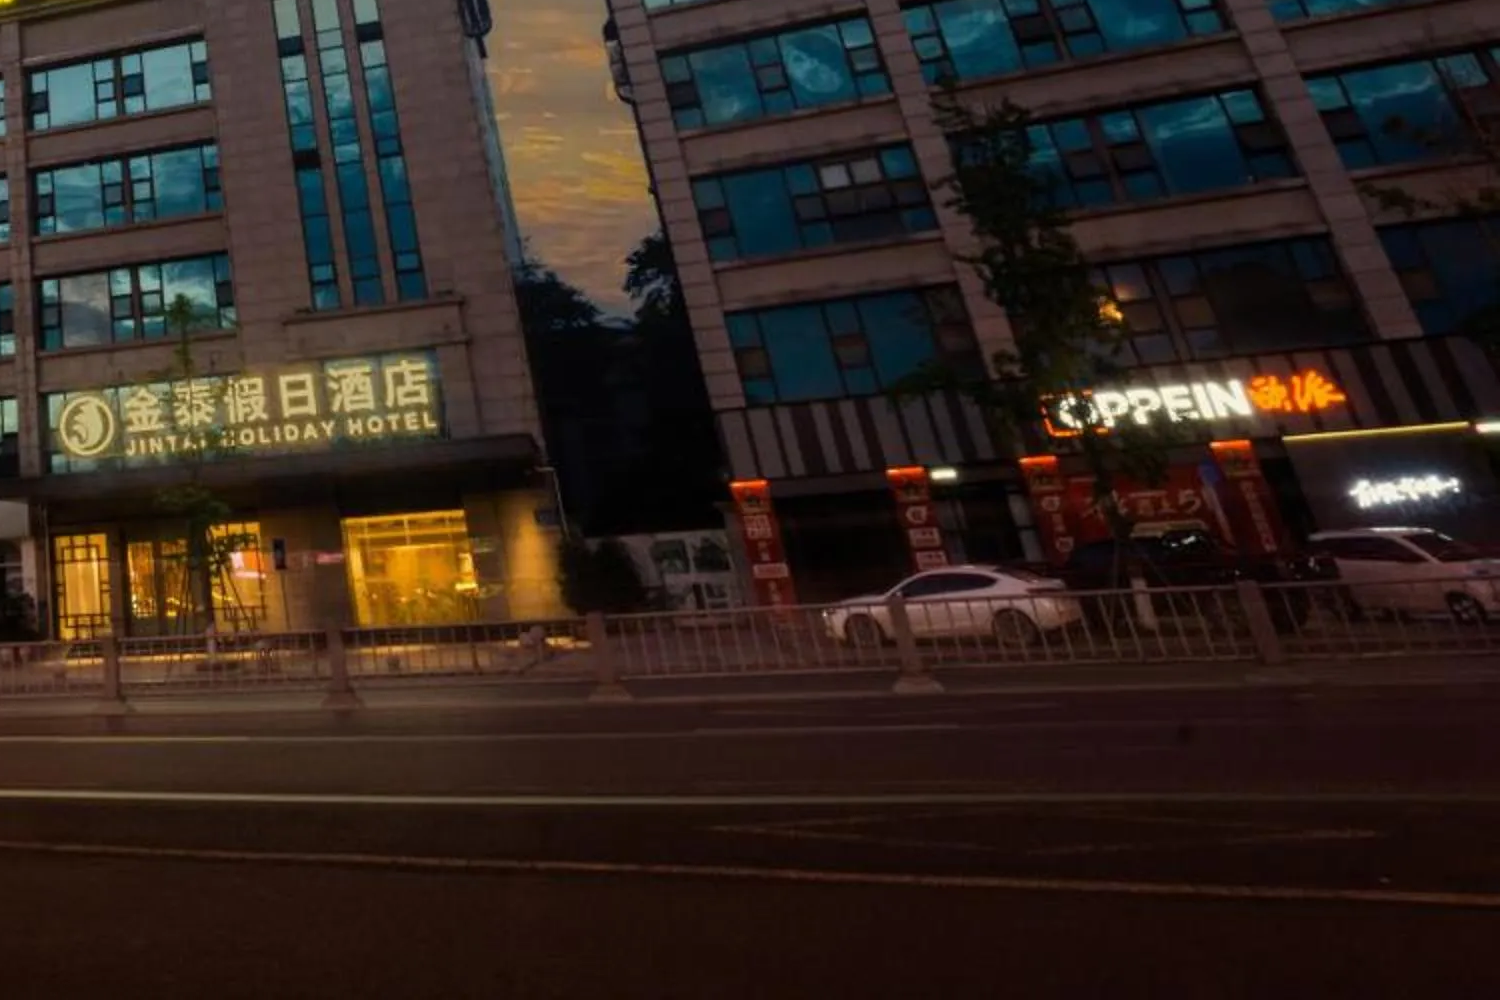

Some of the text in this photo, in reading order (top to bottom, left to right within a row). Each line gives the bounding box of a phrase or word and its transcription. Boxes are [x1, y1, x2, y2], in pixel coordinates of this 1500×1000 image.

[124, 360, 430, 433] 金泰假日酒店
[1058, 379, 1252, 429] OPPEIN
[347, 411, 438, 438] HOTEL
